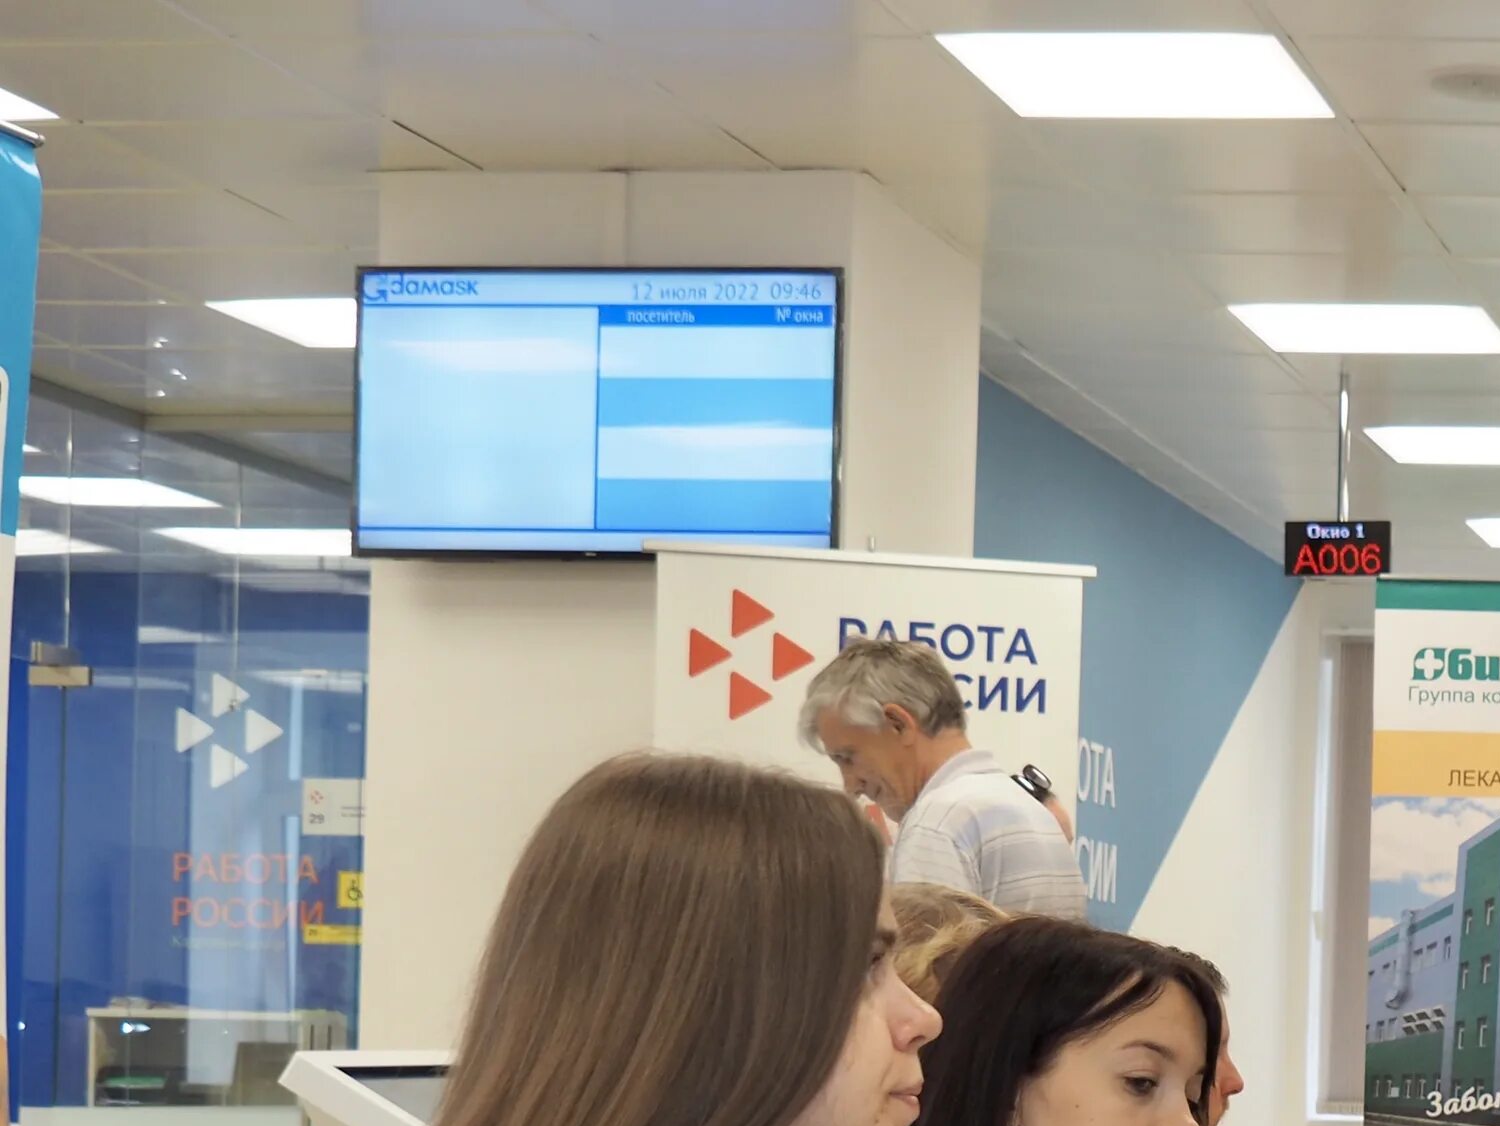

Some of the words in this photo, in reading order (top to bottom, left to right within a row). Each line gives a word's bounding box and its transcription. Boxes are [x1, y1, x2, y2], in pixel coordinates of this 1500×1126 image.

[632, 283, 653, 301] 12
[660, 286, 707, 300] июля
[714, 282, 759, 301] 2022
[770, 281, 822, 300] 09:46
[626, 309, 696, 324] посетитель
[795, 311, 824, 323] окна
[1306, 523, 1350, 539] Окно
[1355, 523, 1365, 539] 1
[1408, 686, 1475, 705] Группа
[1078, 737, 1116, 809] ОТА
[172, 853, 320, 884] РАБОТА
[172, 896, 325, 929] РОССИИ
